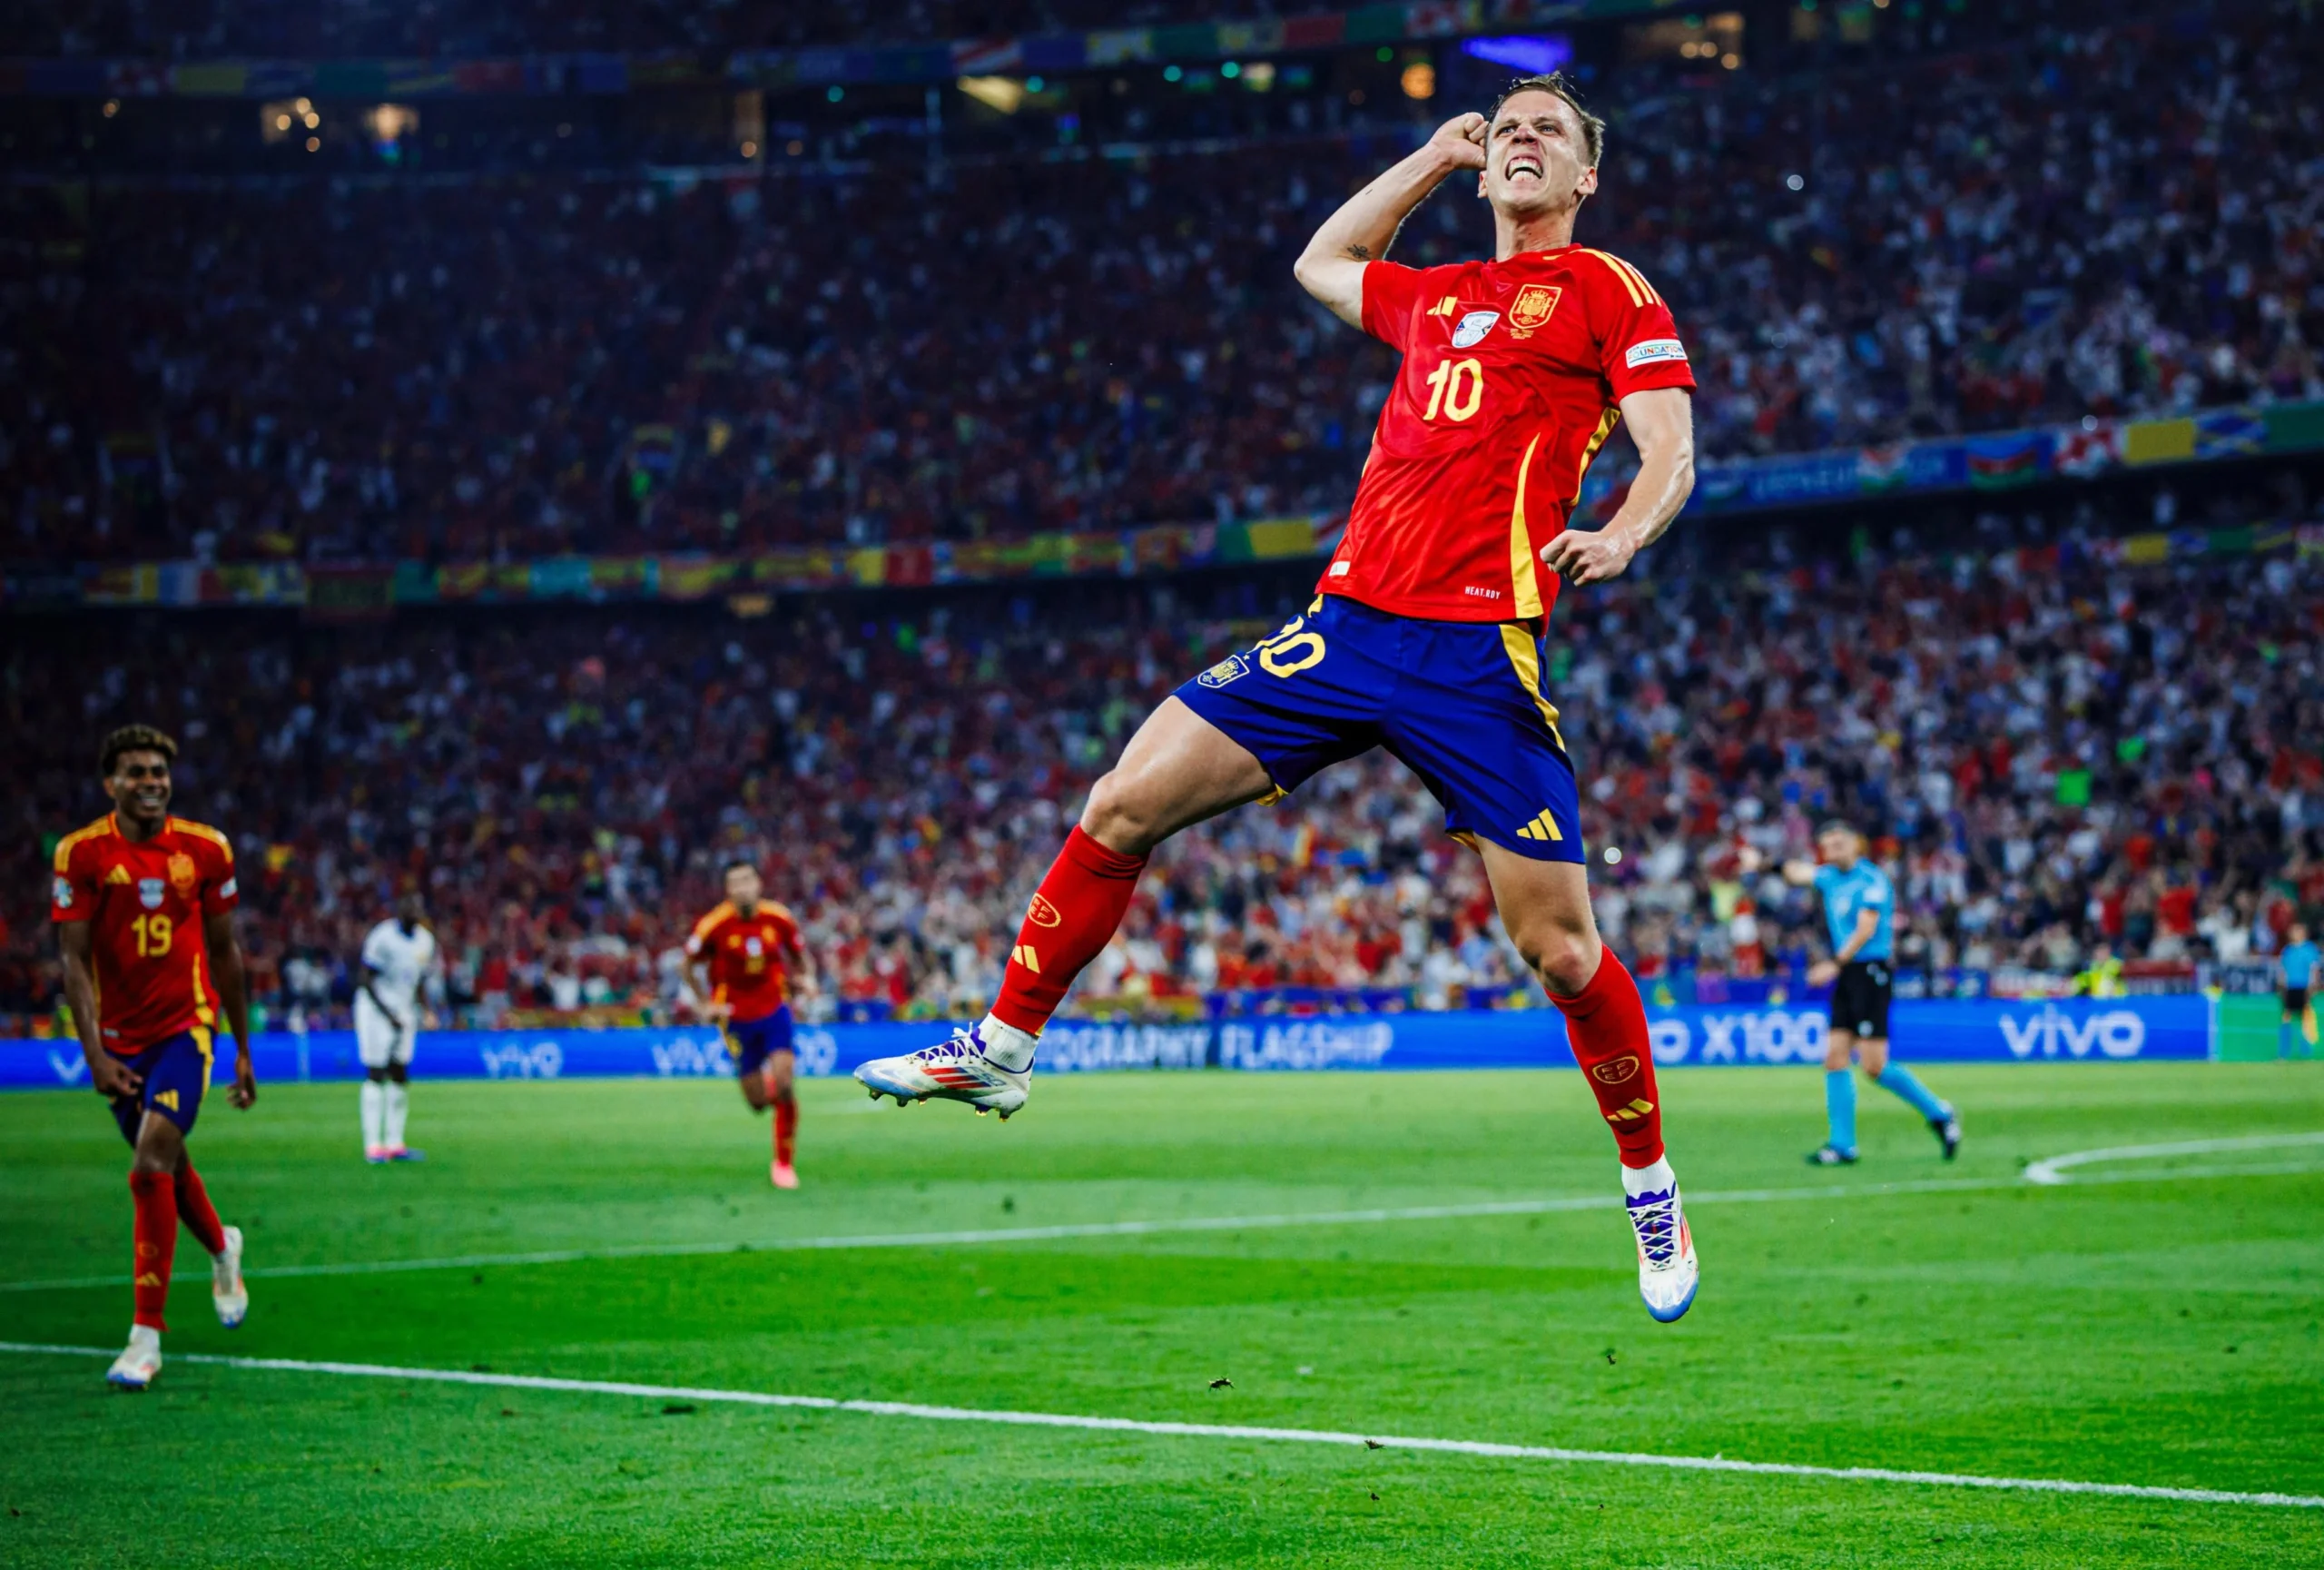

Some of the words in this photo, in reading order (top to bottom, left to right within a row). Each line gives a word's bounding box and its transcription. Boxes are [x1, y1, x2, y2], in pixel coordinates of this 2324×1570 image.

[1423, 358, 1483, 422] 10
[1464, 586, 1501, 600] HEAT.RDY
[132, 913, 172, 957] 19
[1700, 1011, 1830, 1063] X100
[1999, 1002, 2145, 1058] vivo
